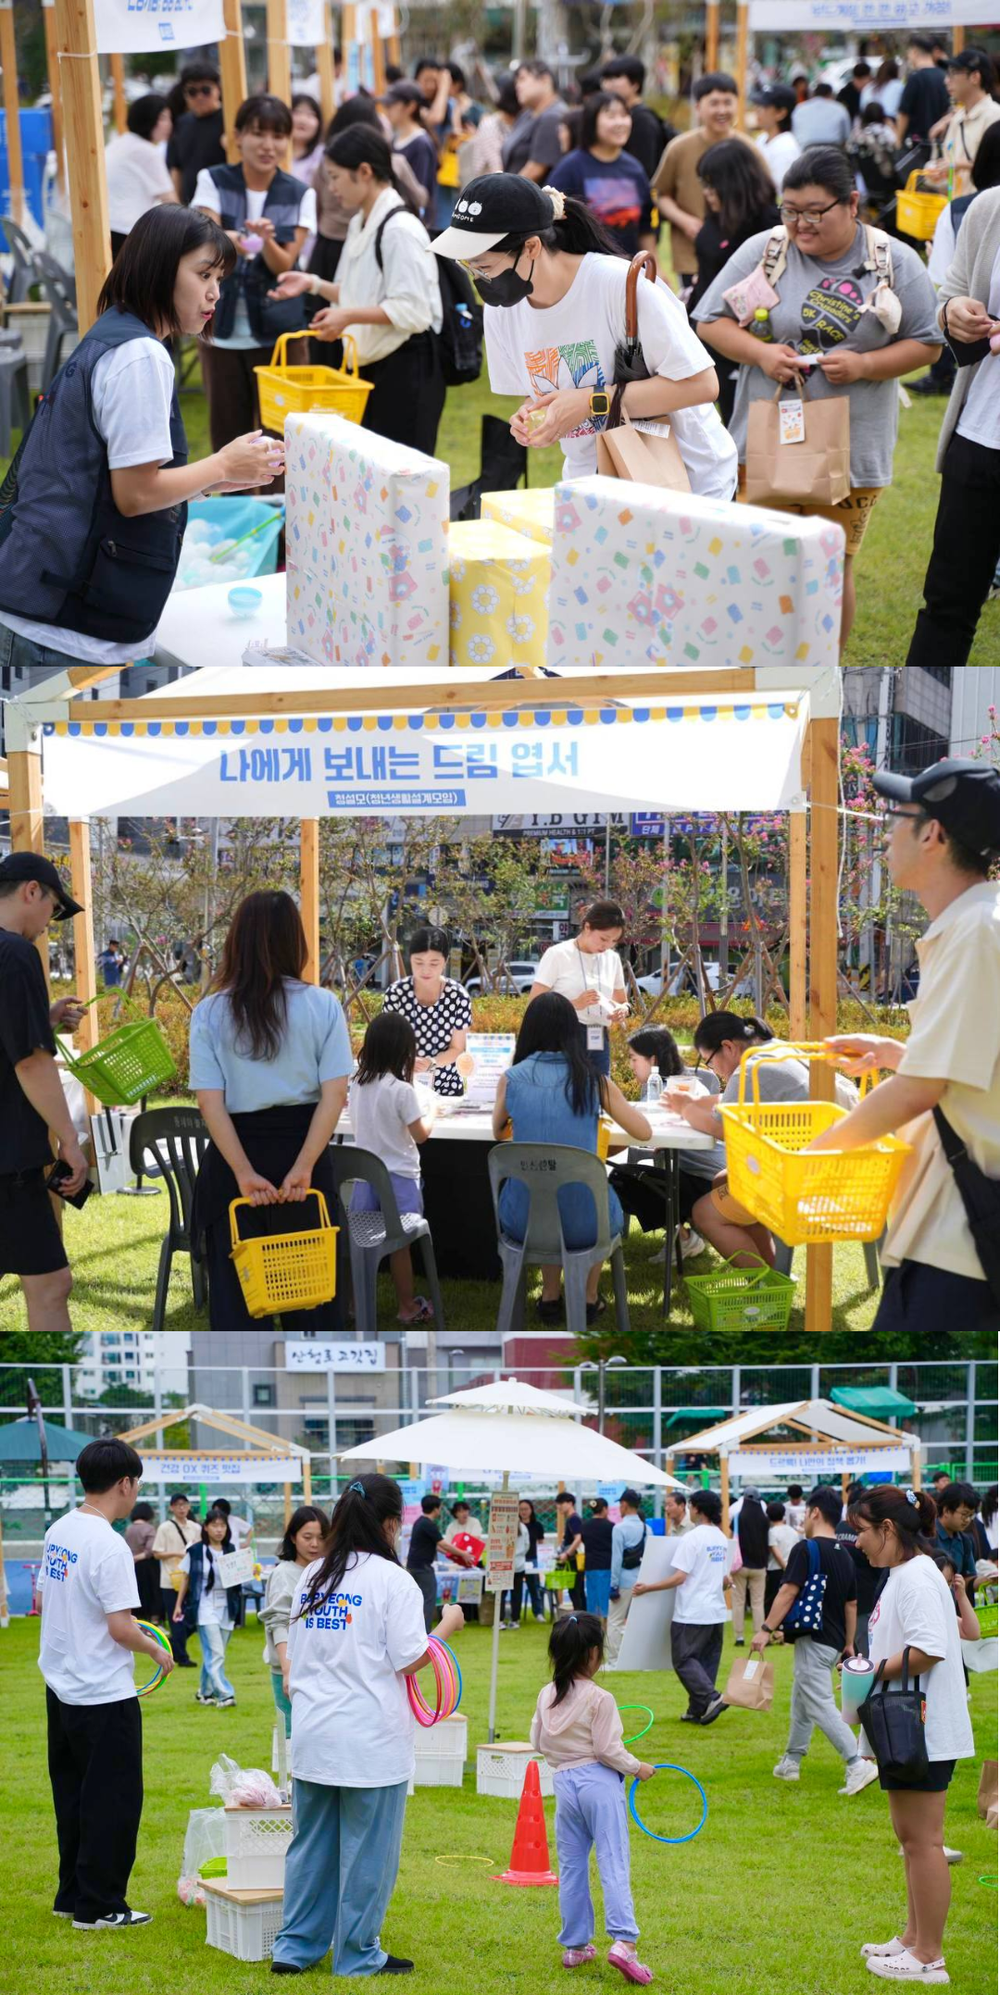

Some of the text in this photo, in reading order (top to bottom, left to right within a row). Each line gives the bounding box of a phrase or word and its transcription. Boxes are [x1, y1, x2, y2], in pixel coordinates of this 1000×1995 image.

[803, 308, 817, 319] 5K
[815, 319, 846, 343] RACE
[219, 741, 579, 782] 나에게 보내는 드림 엽서
[522, 829, 548, 837] PREMIUM
[549, 828, 571, 836] HEALTH
[182, 1464, 198, 1474] OX
[201, 1463, 219, 1474] 퀴즈
[305, 1617, 347, 1631] IS BEST
